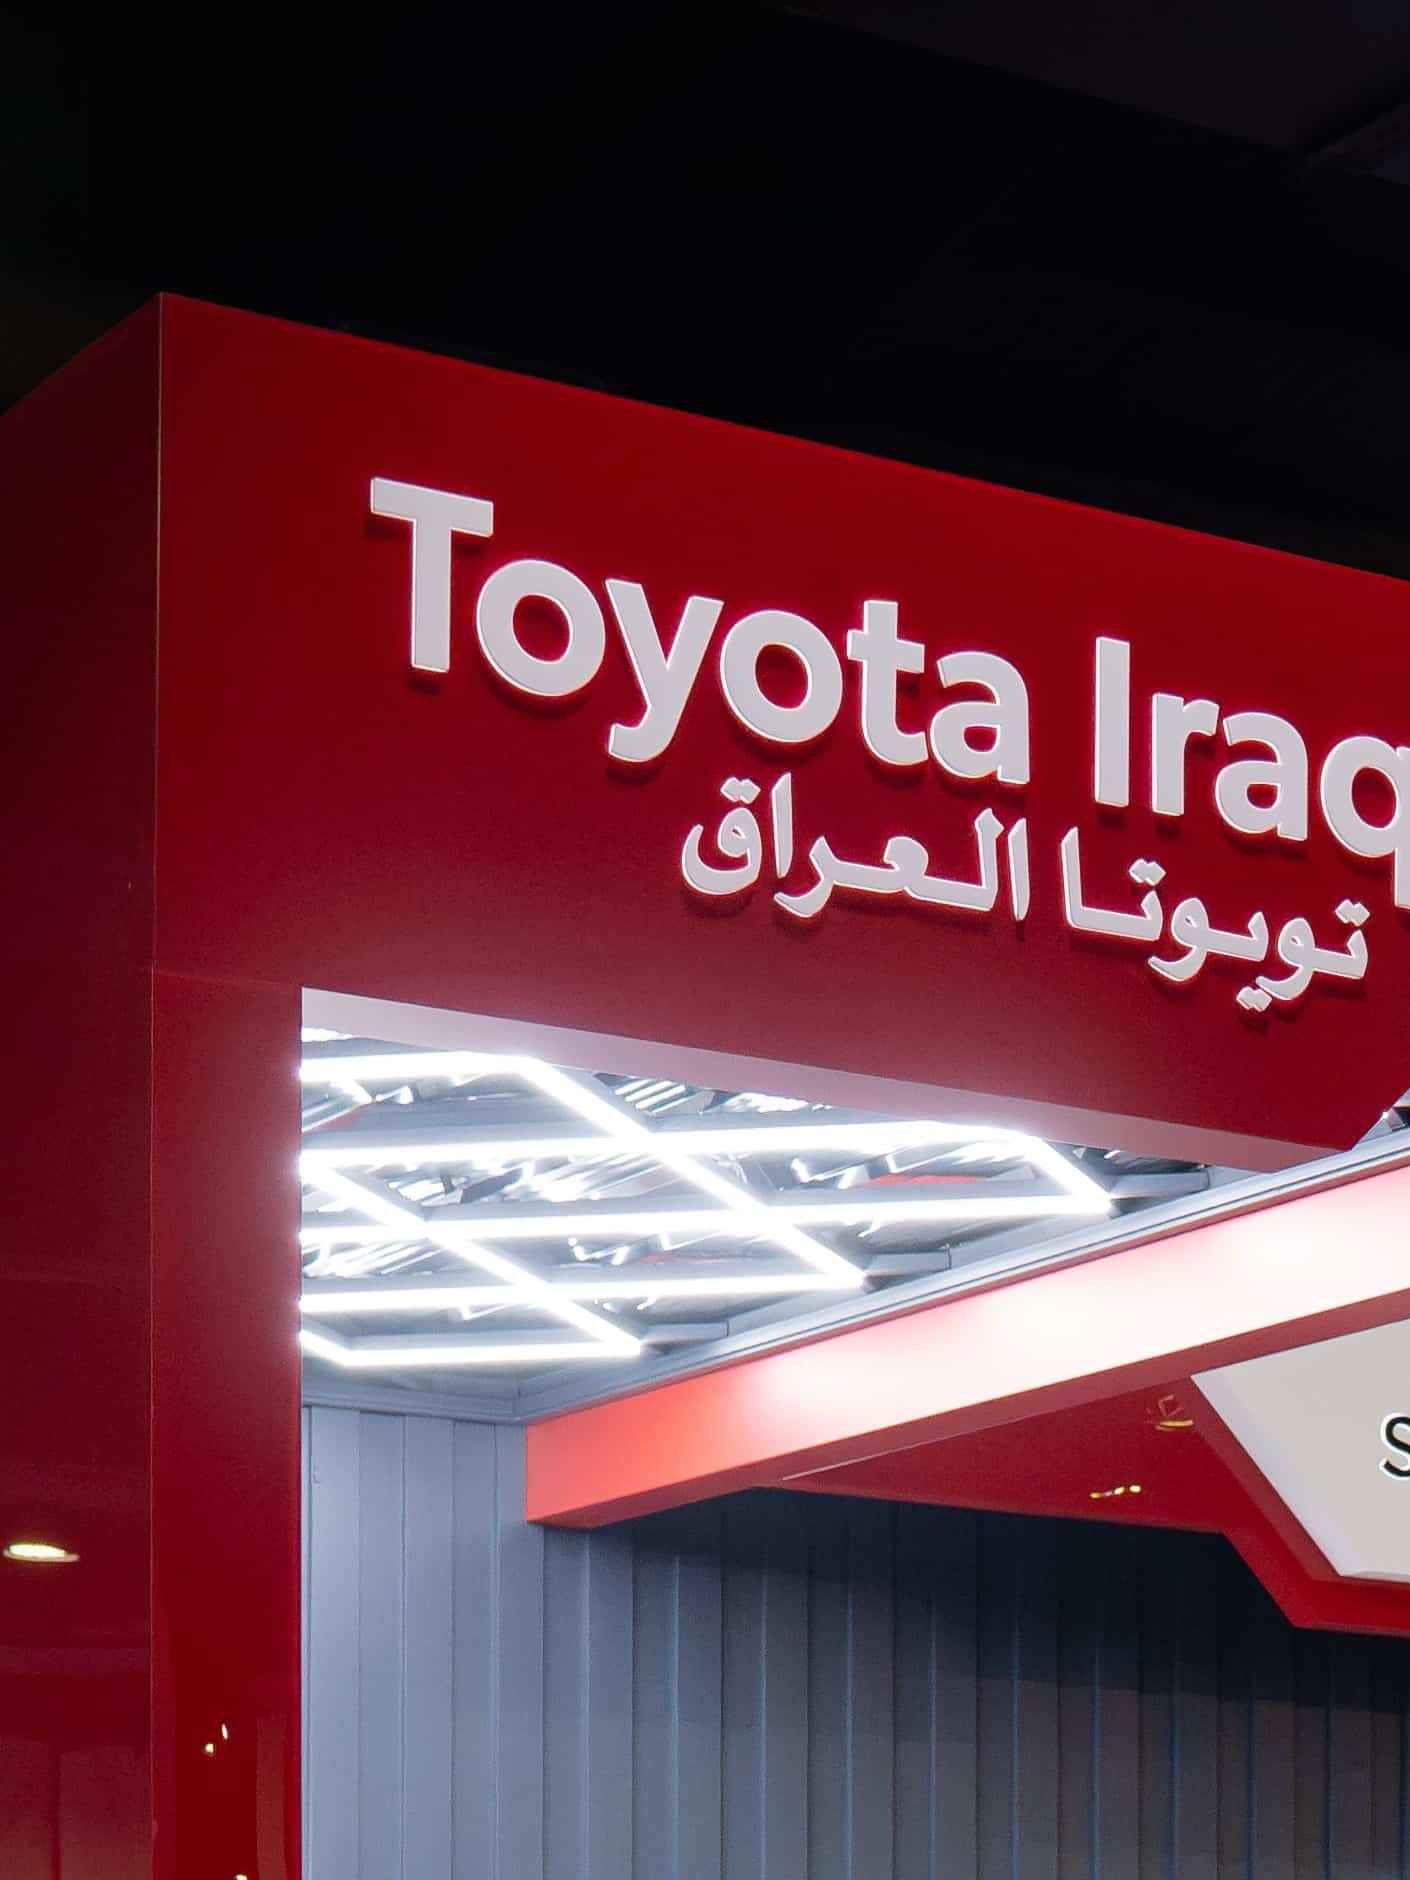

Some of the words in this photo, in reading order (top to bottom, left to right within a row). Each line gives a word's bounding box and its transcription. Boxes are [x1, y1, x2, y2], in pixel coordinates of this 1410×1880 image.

[371, 478, 1029, 784] Toyota
[682, 773, 1029, 920] العراق
[1061, 826, 1368, 1011] تويوتا
